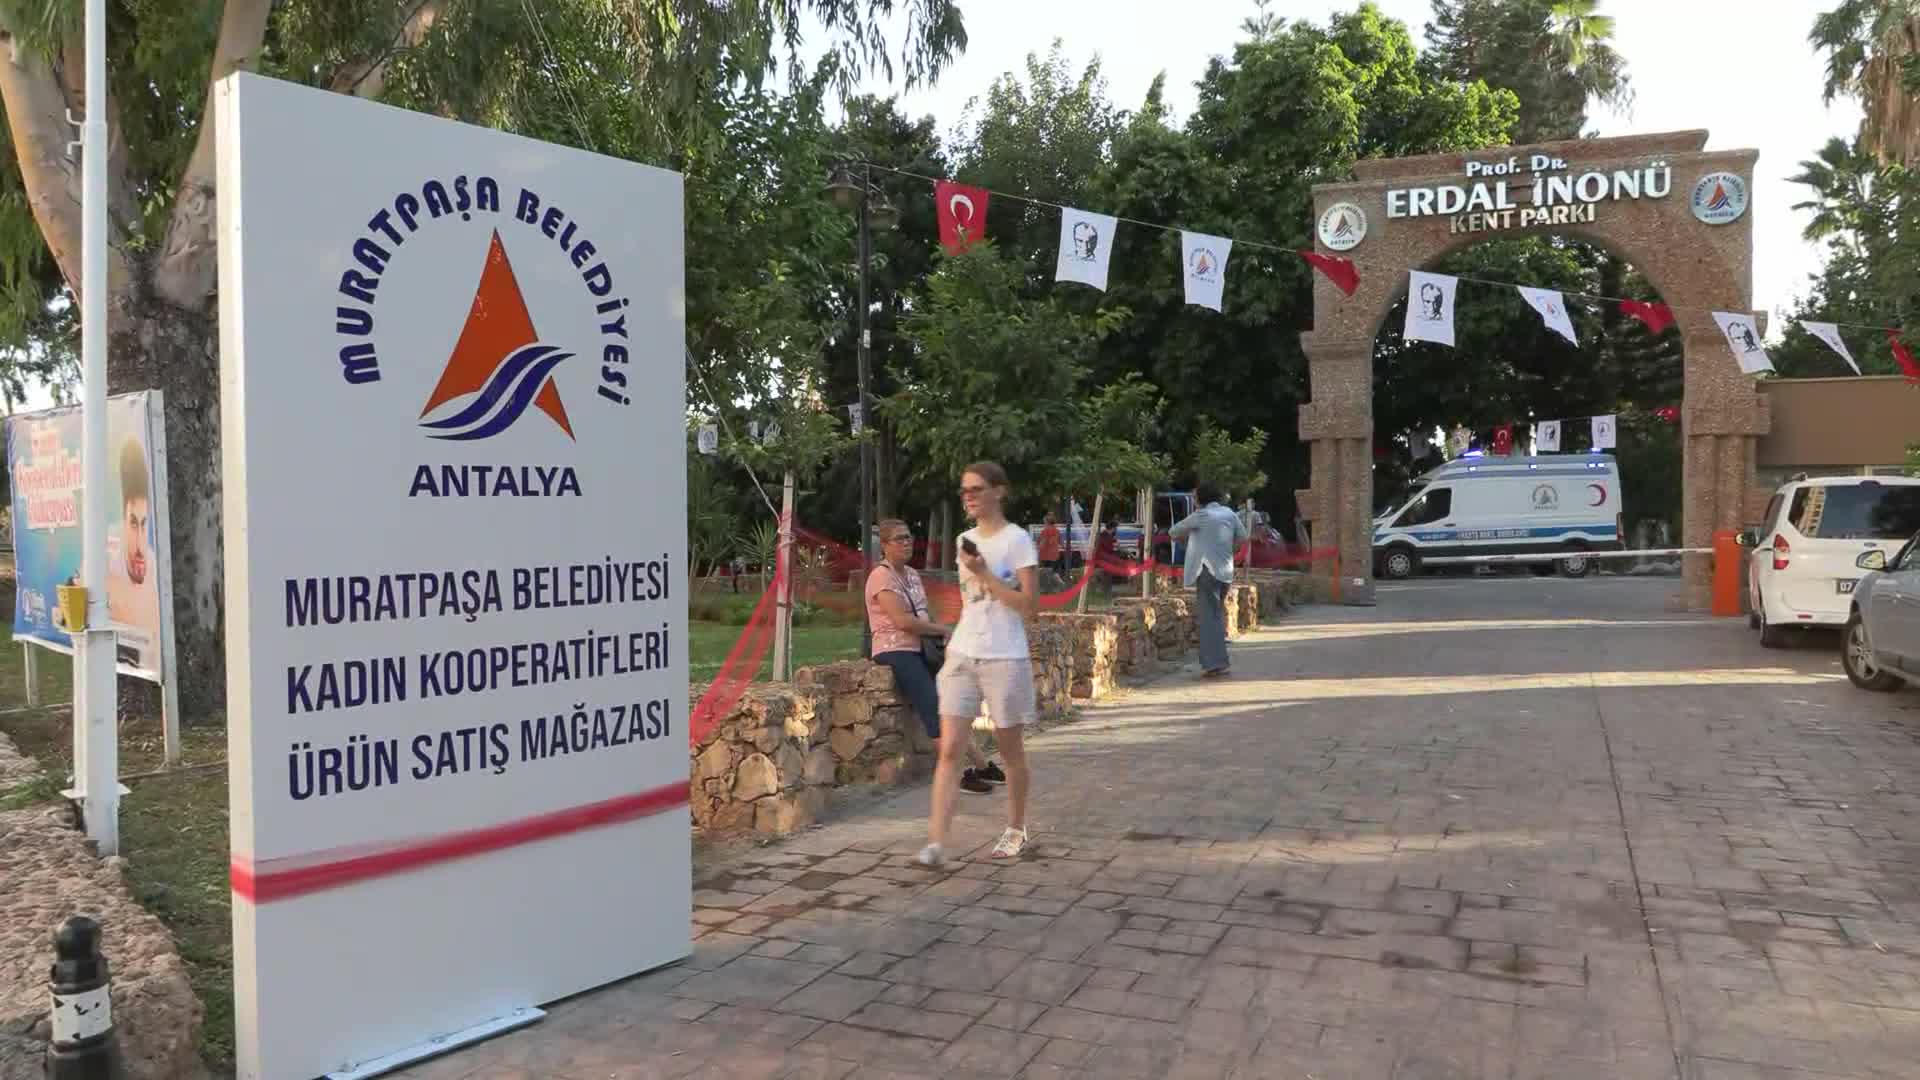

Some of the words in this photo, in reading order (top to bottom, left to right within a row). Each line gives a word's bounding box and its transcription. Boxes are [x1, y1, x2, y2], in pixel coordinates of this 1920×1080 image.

[1466, 156, 1521, 177] Prof.
[1531, 154, 1567, 171] Dr.
[1386, 181, 1517, 219] ERDAL
[1450, 210, 1515, 234] KENT
[1520, 203, 1596, 227] PARKI
[336, 175, 500, 385] MURATPAŞA
[516, 188, 631, 406] BELEDİYESİ
[408, 464, 583, 497] ANTALYA
[285, 569, 503, 628] MURATPAŞA
[512, 552, 669, 611] BELEDİYESİ
[287, 655, 407, 715] KADIN
[419, 621, 669, 699] KOOPERATİFLERİ
[288, 734, 399, 801] ÜRÜN
[411, 723, 510, 776] SATIŞ
[520, 698, 670, 763] MAĞAZASI
